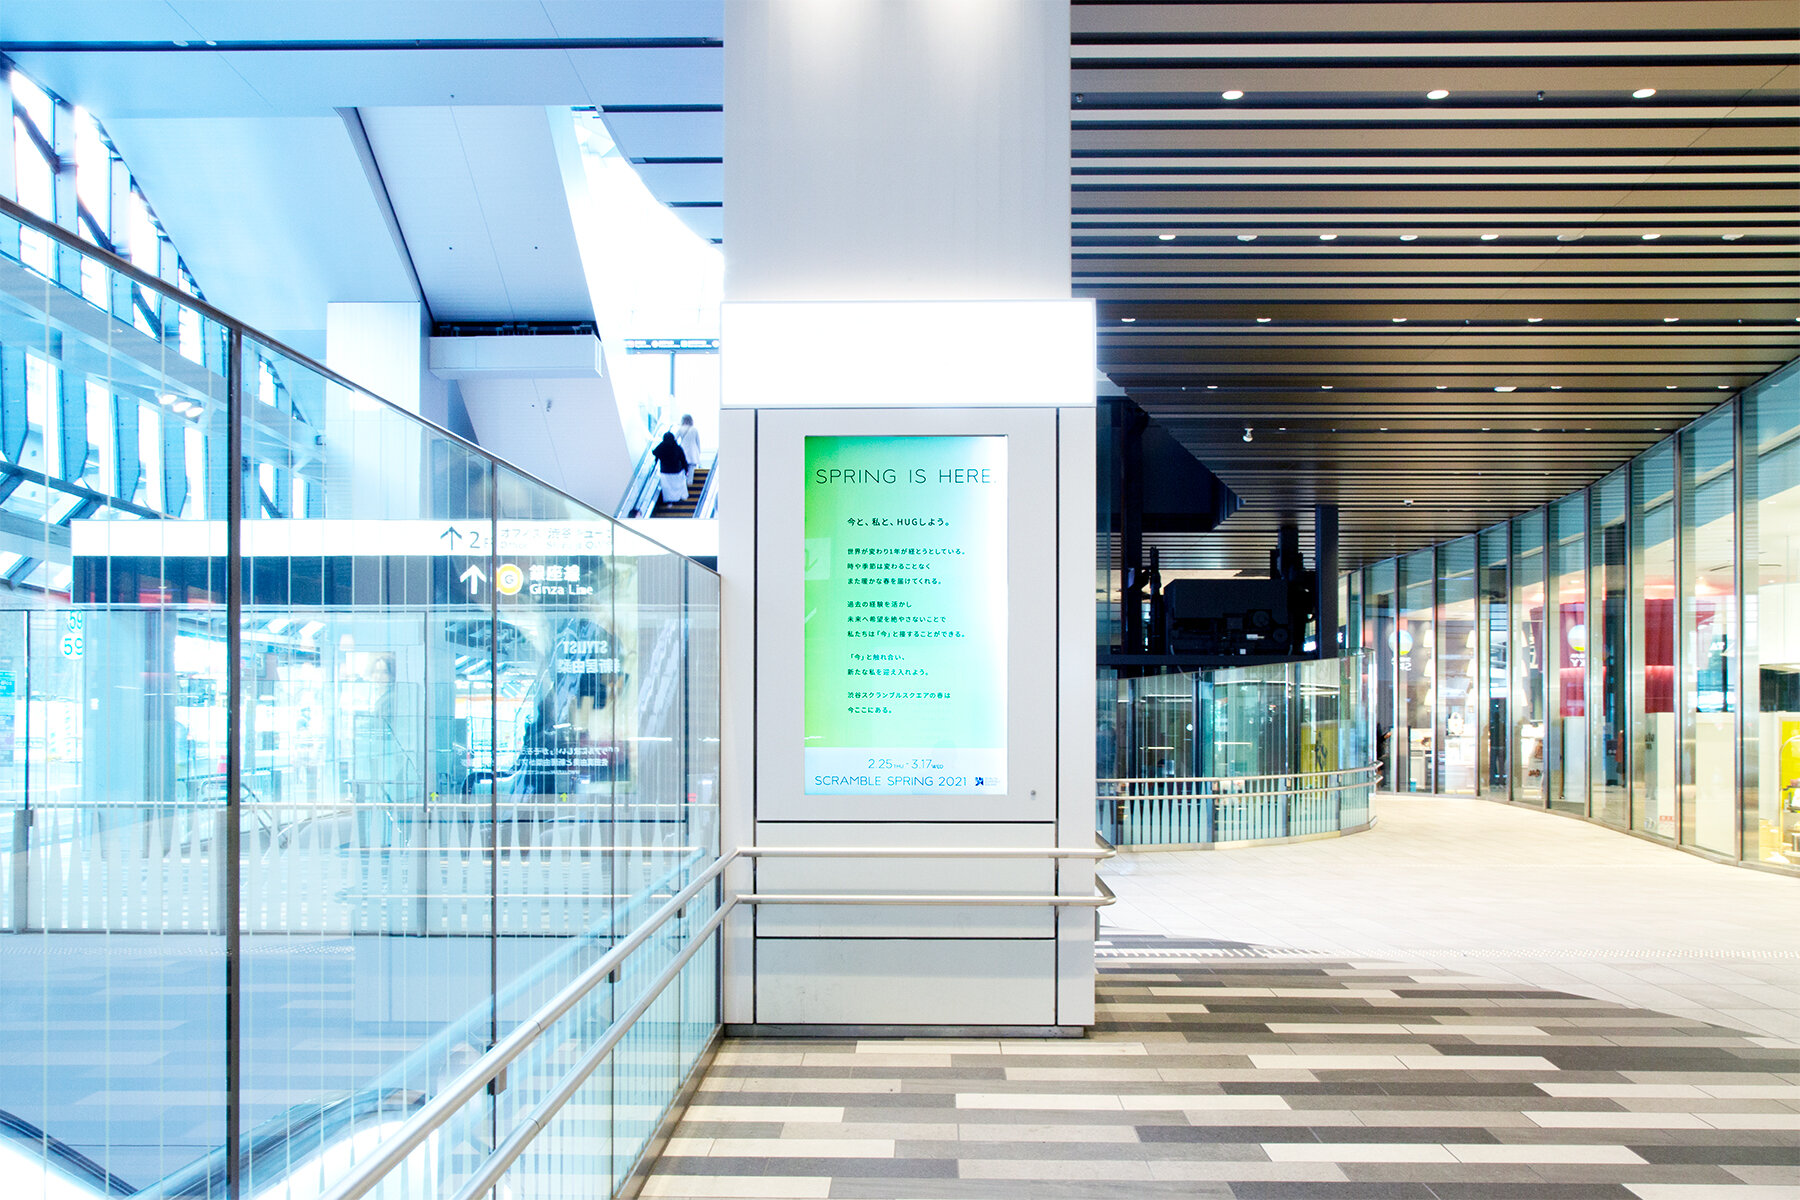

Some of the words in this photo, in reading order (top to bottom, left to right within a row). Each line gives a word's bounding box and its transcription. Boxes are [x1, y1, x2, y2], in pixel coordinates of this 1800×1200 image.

[815, 468, 897, 484] SPRING
[909, 468, 927, 484] IS
[847, 517, 950, 527] 今と、私と、HUGしよう。
[847, 577, 942, 585] また暖かな春を届けてくれる。
[529, 583, 564, 595] Ginza
[568, 584, 594, 595] Line
[63, 637, 84, 656] 59
[850, 653, 905, 661] 「今」と触れ合い、
[847, 668, 929, 676] 新たな私を迎え入れよう。
[847, 691, 951, 699] 渋谷スクランブルスクエアの春は
[847, 706, 893, 714] 今ここにある。
[814, 775, 882, 786] SCRAMBLE
[887, 776, 934, 786] SPRING
[938, 776, 967, 786] 2021
